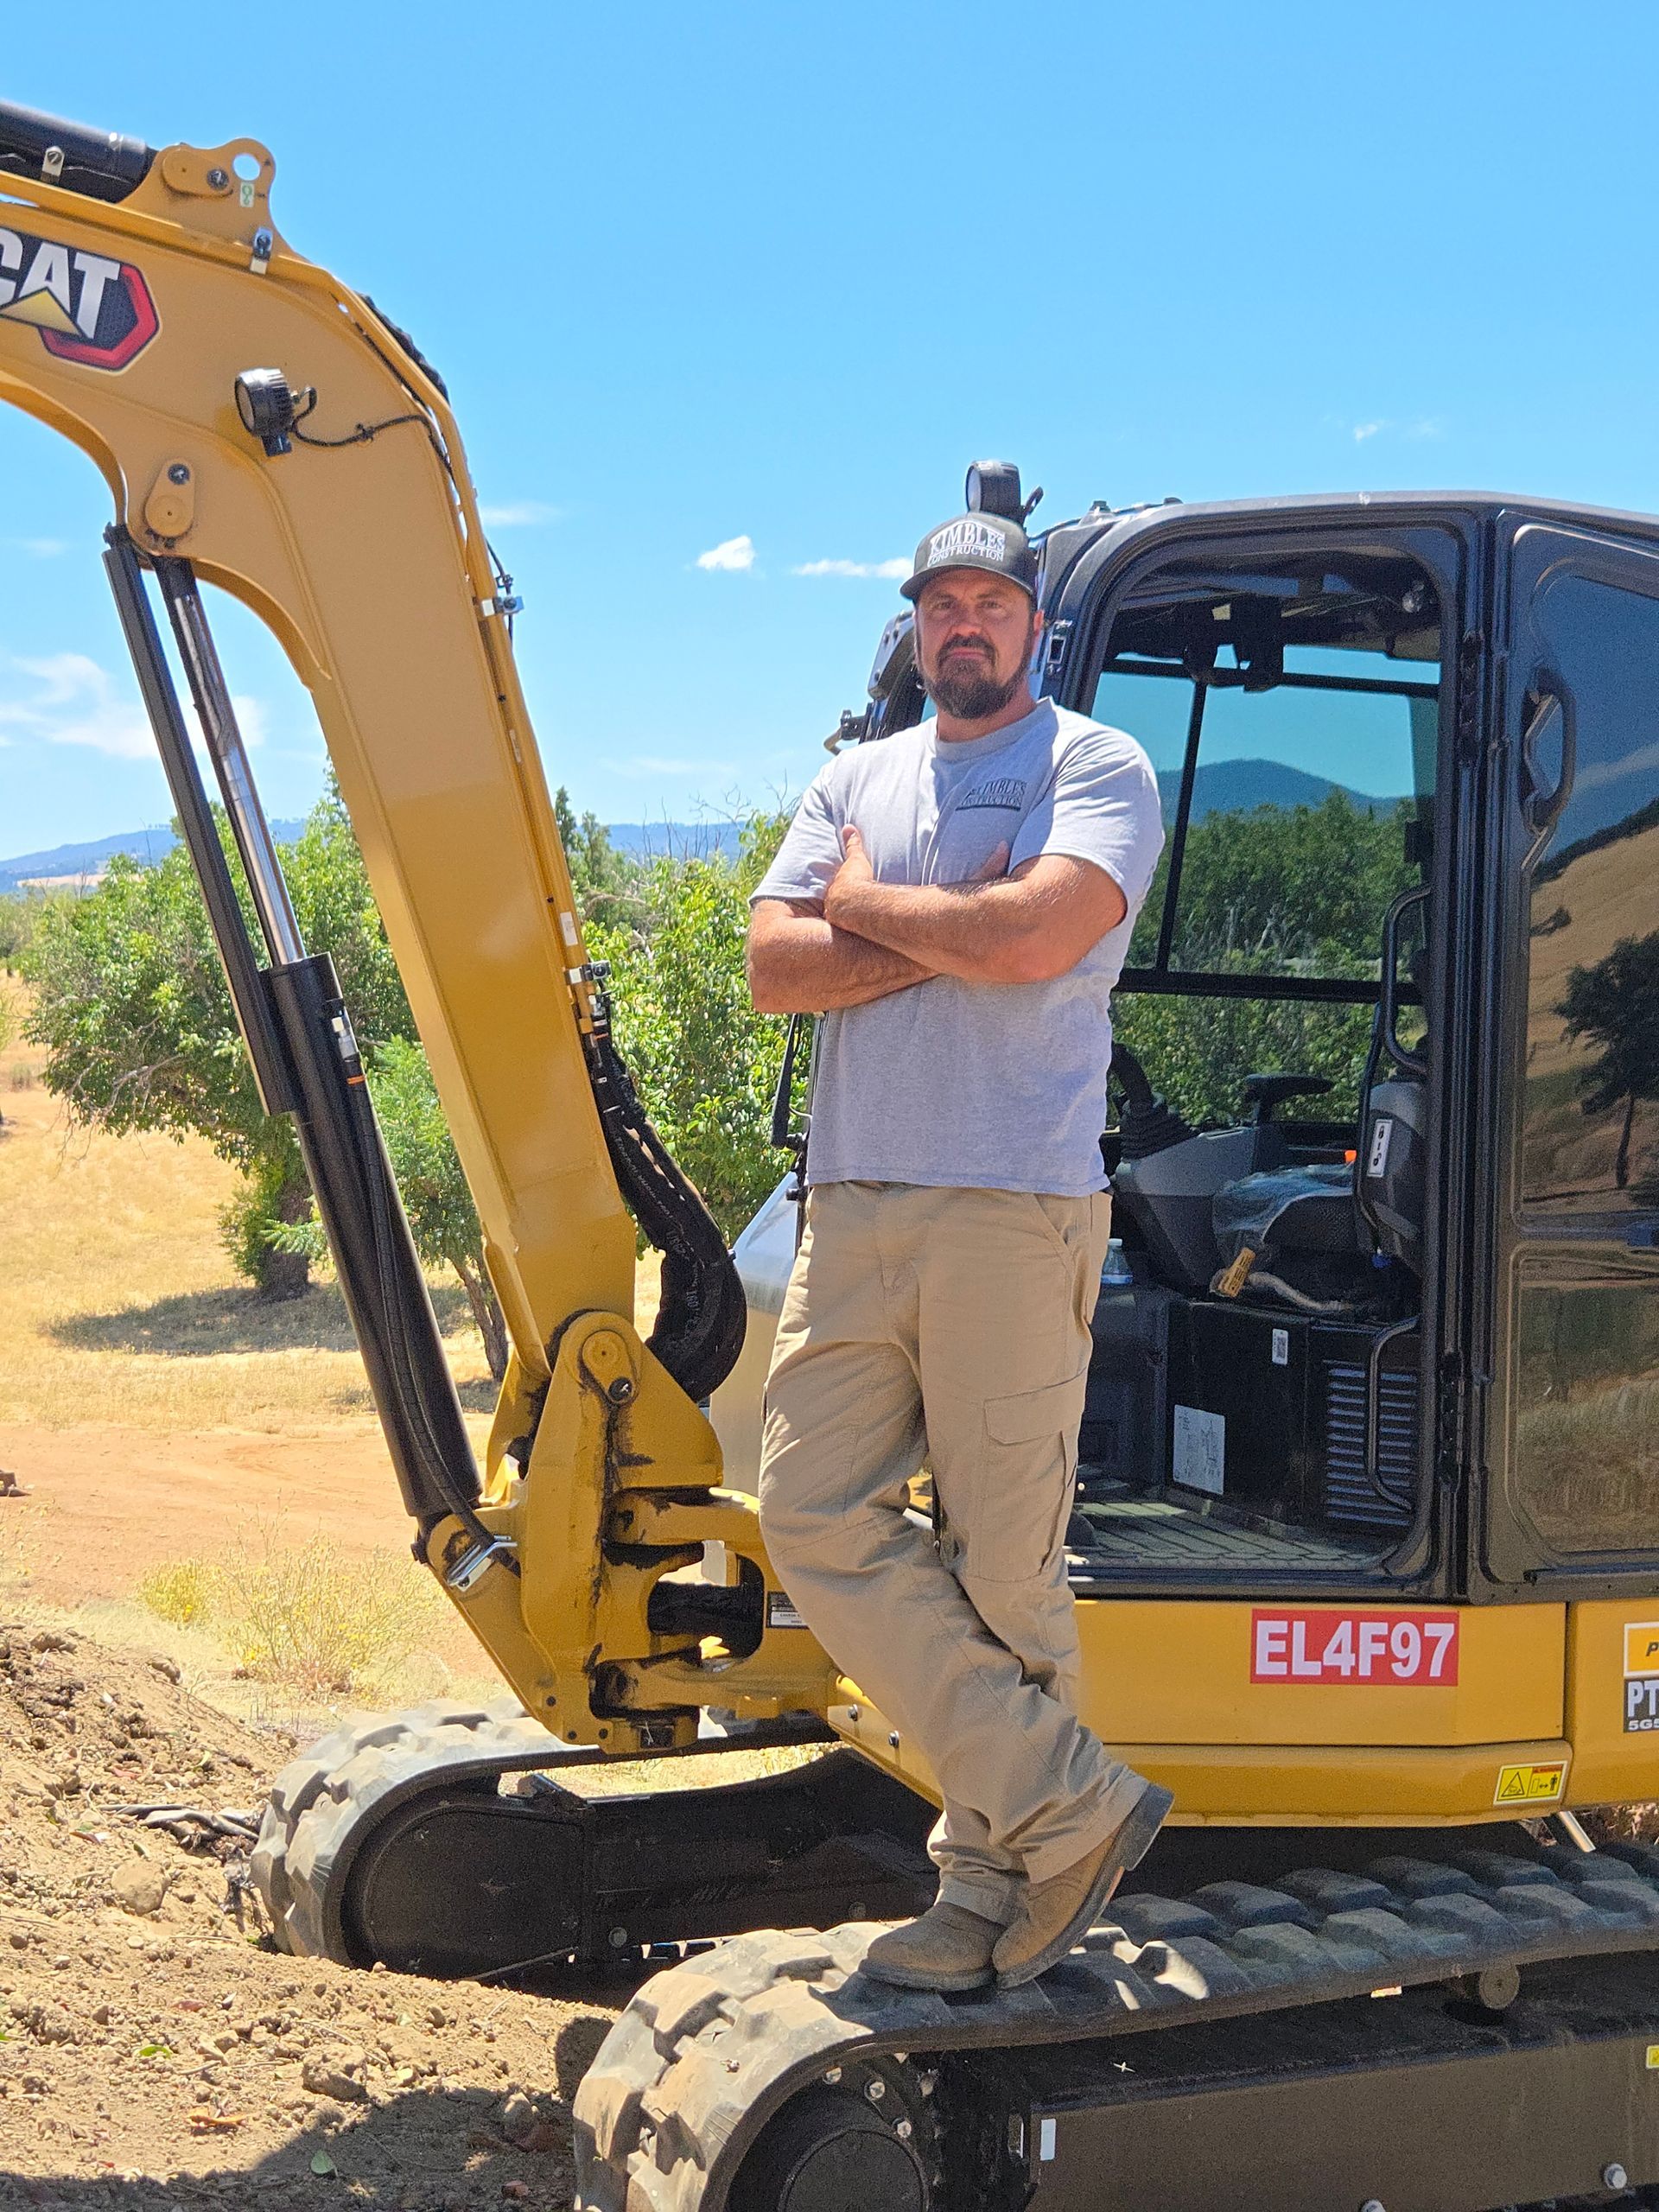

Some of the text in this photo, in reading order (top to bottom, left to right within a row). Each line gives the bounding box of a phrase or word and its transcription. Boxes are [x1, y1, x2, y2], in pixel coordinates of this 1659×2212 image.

[930, 523, 1005, 553] KIMBLES
[927, 545, 1004, 567] CONSTRUCTION
[1255, 1620, 1455, 1677] EL4F97
